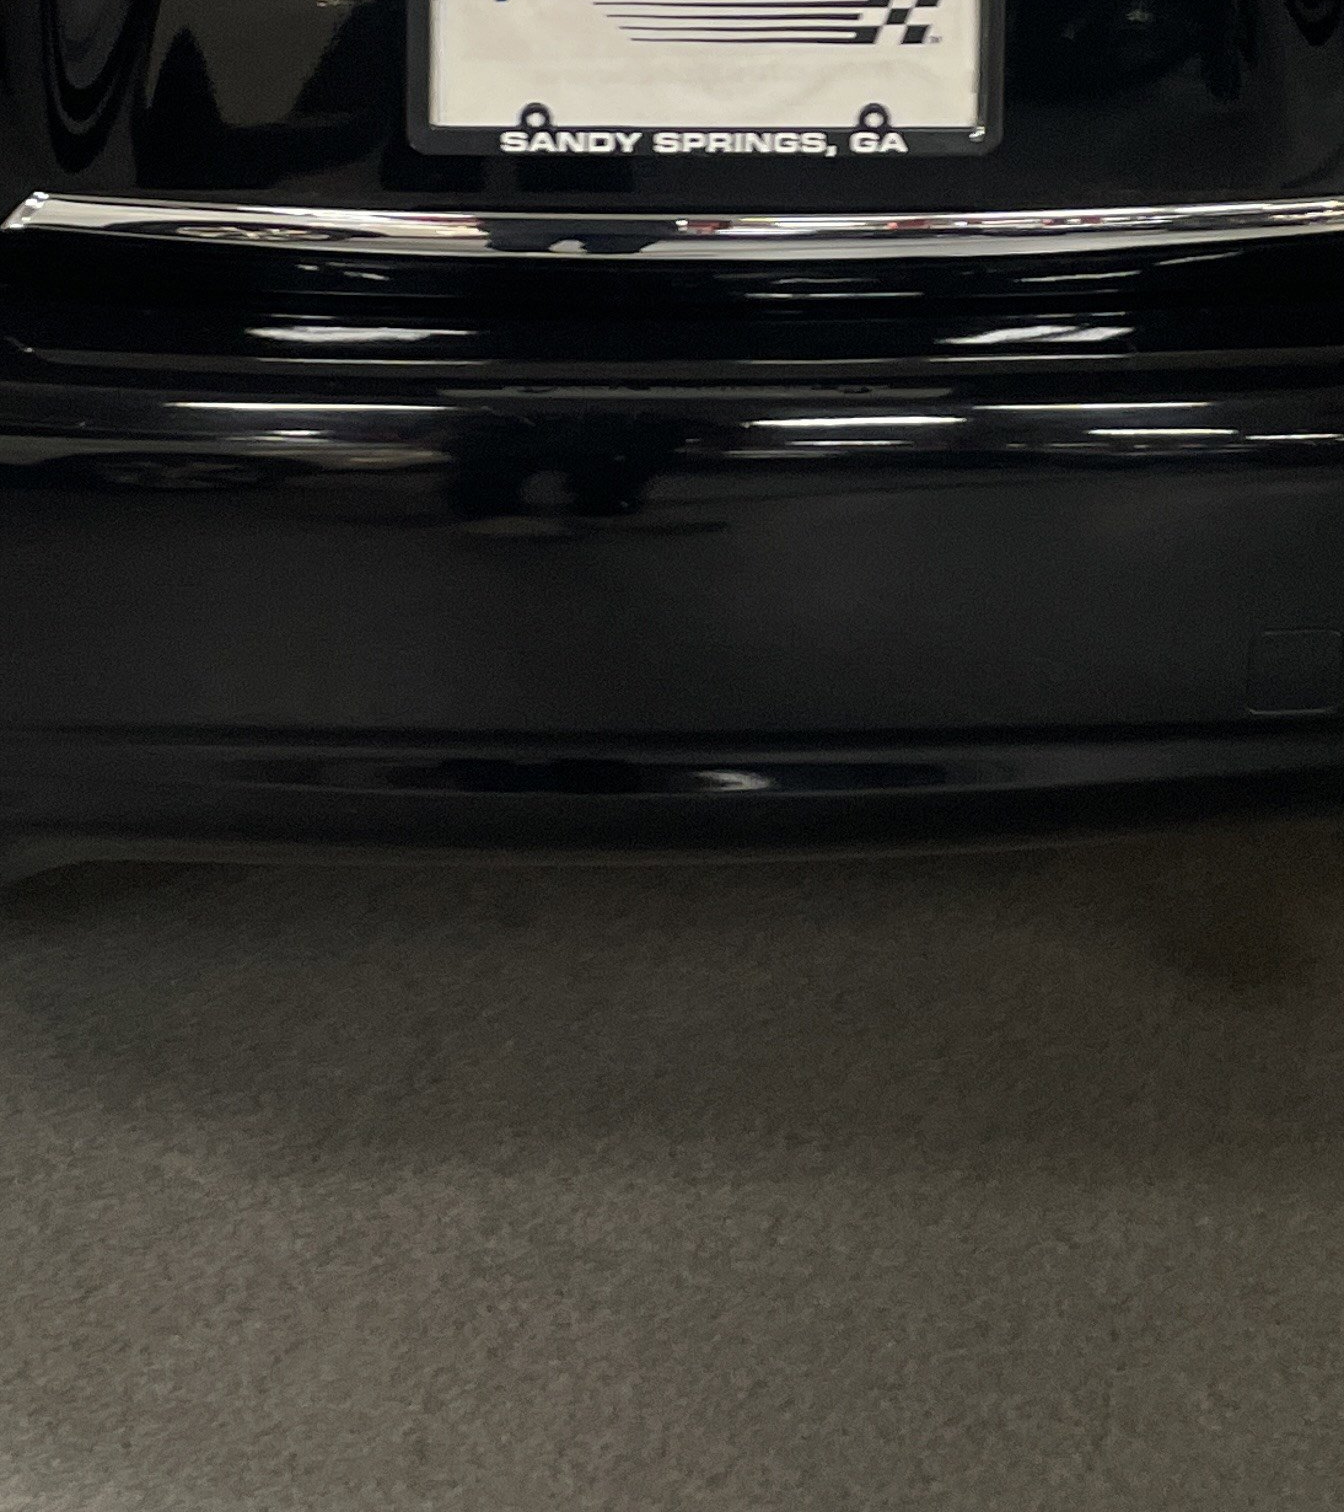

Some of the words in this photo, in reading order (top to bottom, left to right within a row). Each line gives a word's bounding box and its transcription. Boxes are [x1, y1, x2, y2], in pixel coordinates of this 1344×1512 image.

[500, 132, 641, 154] SANDY
[654, 132, 837, 157] SPRINGS,
[849, 132, 908, 154] GA
